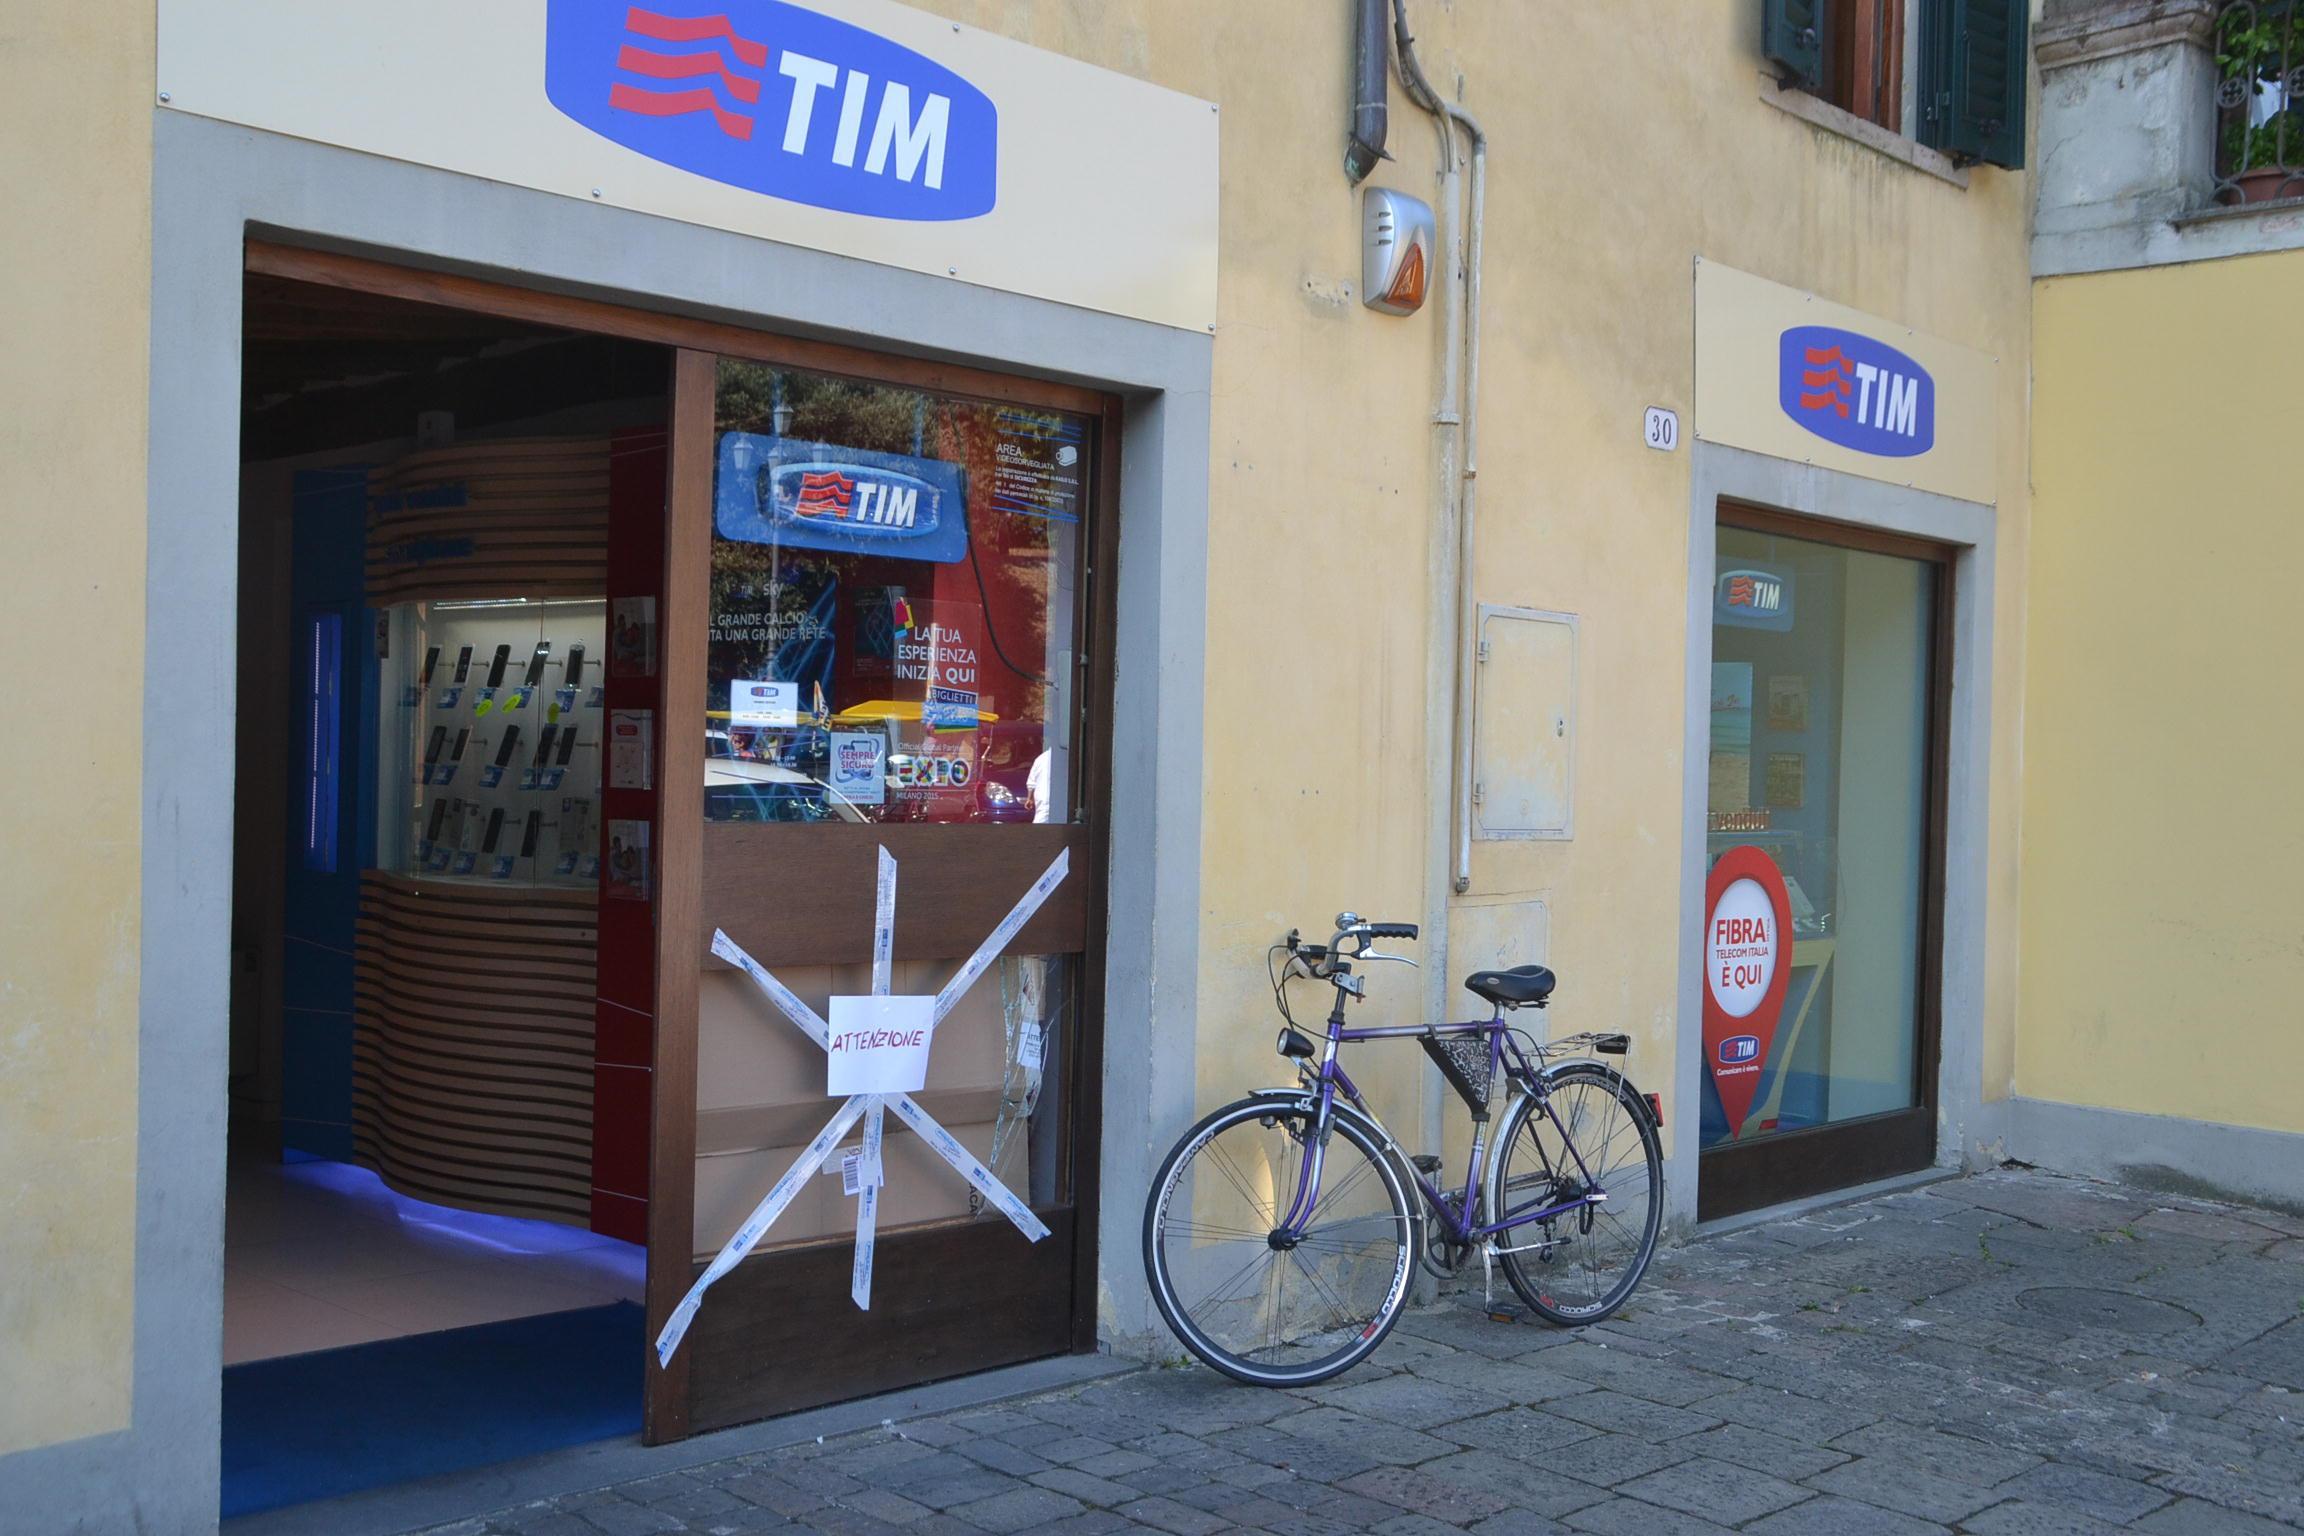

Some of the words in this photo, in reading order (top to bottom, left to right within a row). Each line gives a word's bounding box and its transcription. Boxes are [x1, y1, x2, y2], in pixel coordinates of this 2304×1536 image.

[778, 49, 951, 190] TIM
[1855, 362, 1918, 437] TIM
[1651, 414, 1672, 445] 30
[996, 443, 1022, 457] AREA
[855, 482, 918, 528] TIM
[1753, 582, 1780, 610] TIM
[717, 613, 761, 626] GRANDE
[763, 611, 805, 625] CALCIO
[725, 629, 748, 641] UNA
[751, 628, 796, 641] GRANDE
[799, 627, 826, 640] RETE
[914, 626, 931, 641] LA
[934, 627, 961, 644] TUA
[898, 644, 976, 664] ESPERIENZA
[896, 664, 941, 681] INIZIA
[945, 667, 975, 685] QUI
[931, 690, 973, 704] BIGLIETTI
[841, 751, 875, 760] SEMPRE
[841, 761, 875, 769] SICURO
[897, 756, 971, 787] EXPO
[896, 791, 922, 801] MILANO
[1716, 917, 1766, 945] FIBRA
[1716, 948, 1749, 959] TELECOM
[1749, 947, 1768, 957] ITALIA
[1721, 961, 1730, 987] È
[1734, 964, 1762, 989] QUI
[831, 1028, 924, 1053] ATTENZIONE
[1737, 1040, 1755, 1058] TIM
[1158, 1130, 1215, 1230] CAMPAGNOLO
[1381, 1244, 1406, 1315] SCIROCCO
[1560, 1301, 1602, 1313] SCIROCCO
